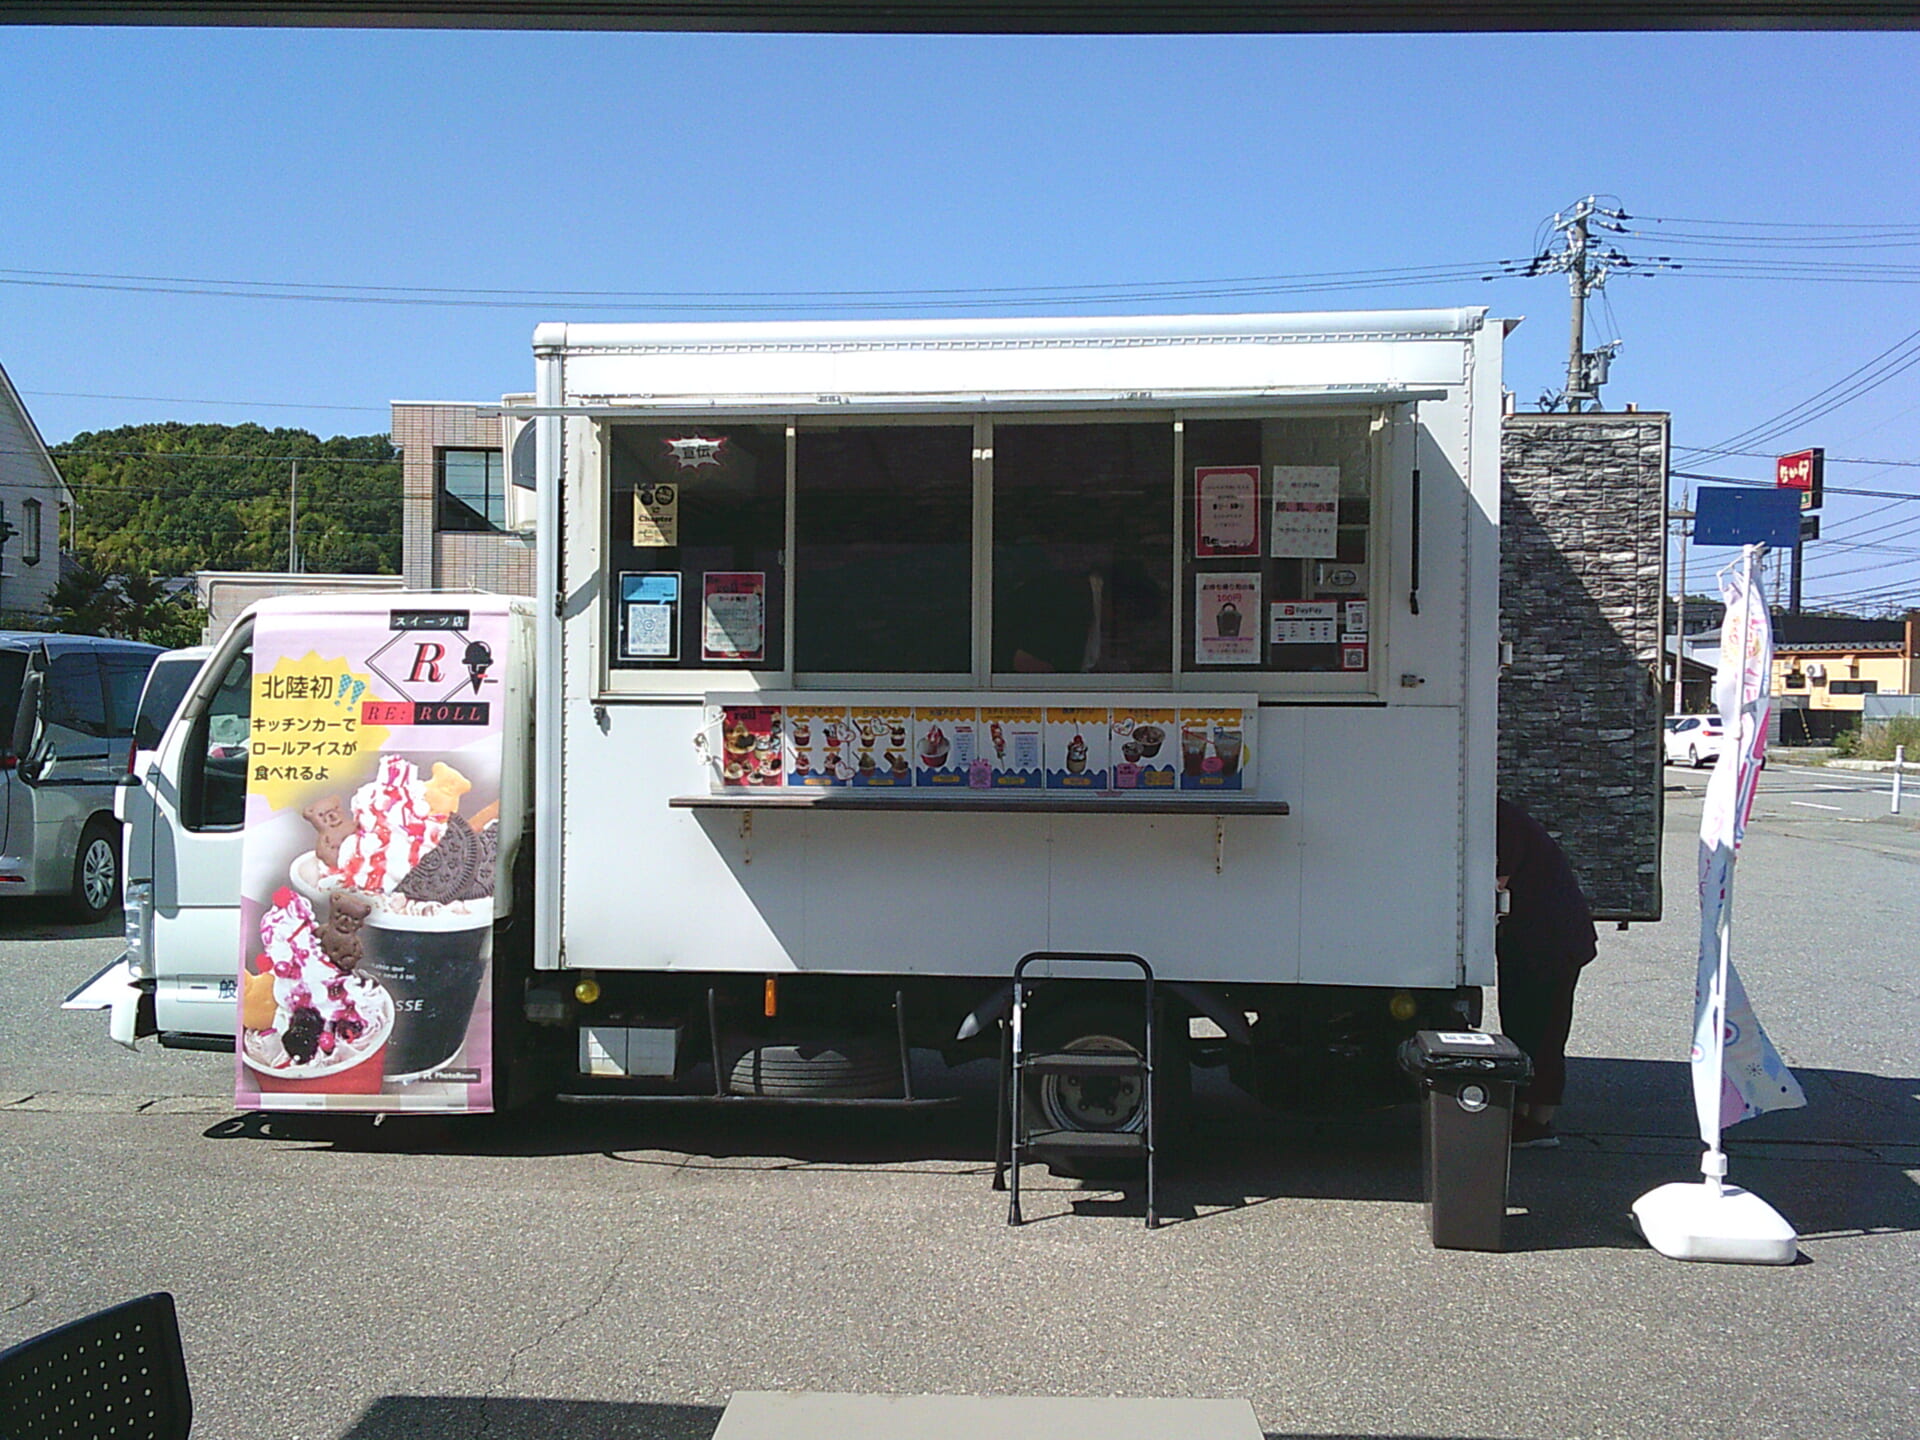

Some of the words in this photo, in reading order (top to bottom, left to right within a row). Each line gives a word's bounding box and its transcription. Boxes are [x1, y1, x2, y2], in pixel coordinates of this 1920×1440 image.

[1217, 593, 1242, 603] 100円
[394, 615, 465, 628] スイーツ店
[402, 641, 447, 683] R
[367, 706, 407, 722] RE:
[419, 705, 483, 722] ROLL
[252, 716, 357, 733] キッチンカーで
[252, 740, 358, 757] ロールアイスが
[254, 764, 330, 781] 食べれるよ
